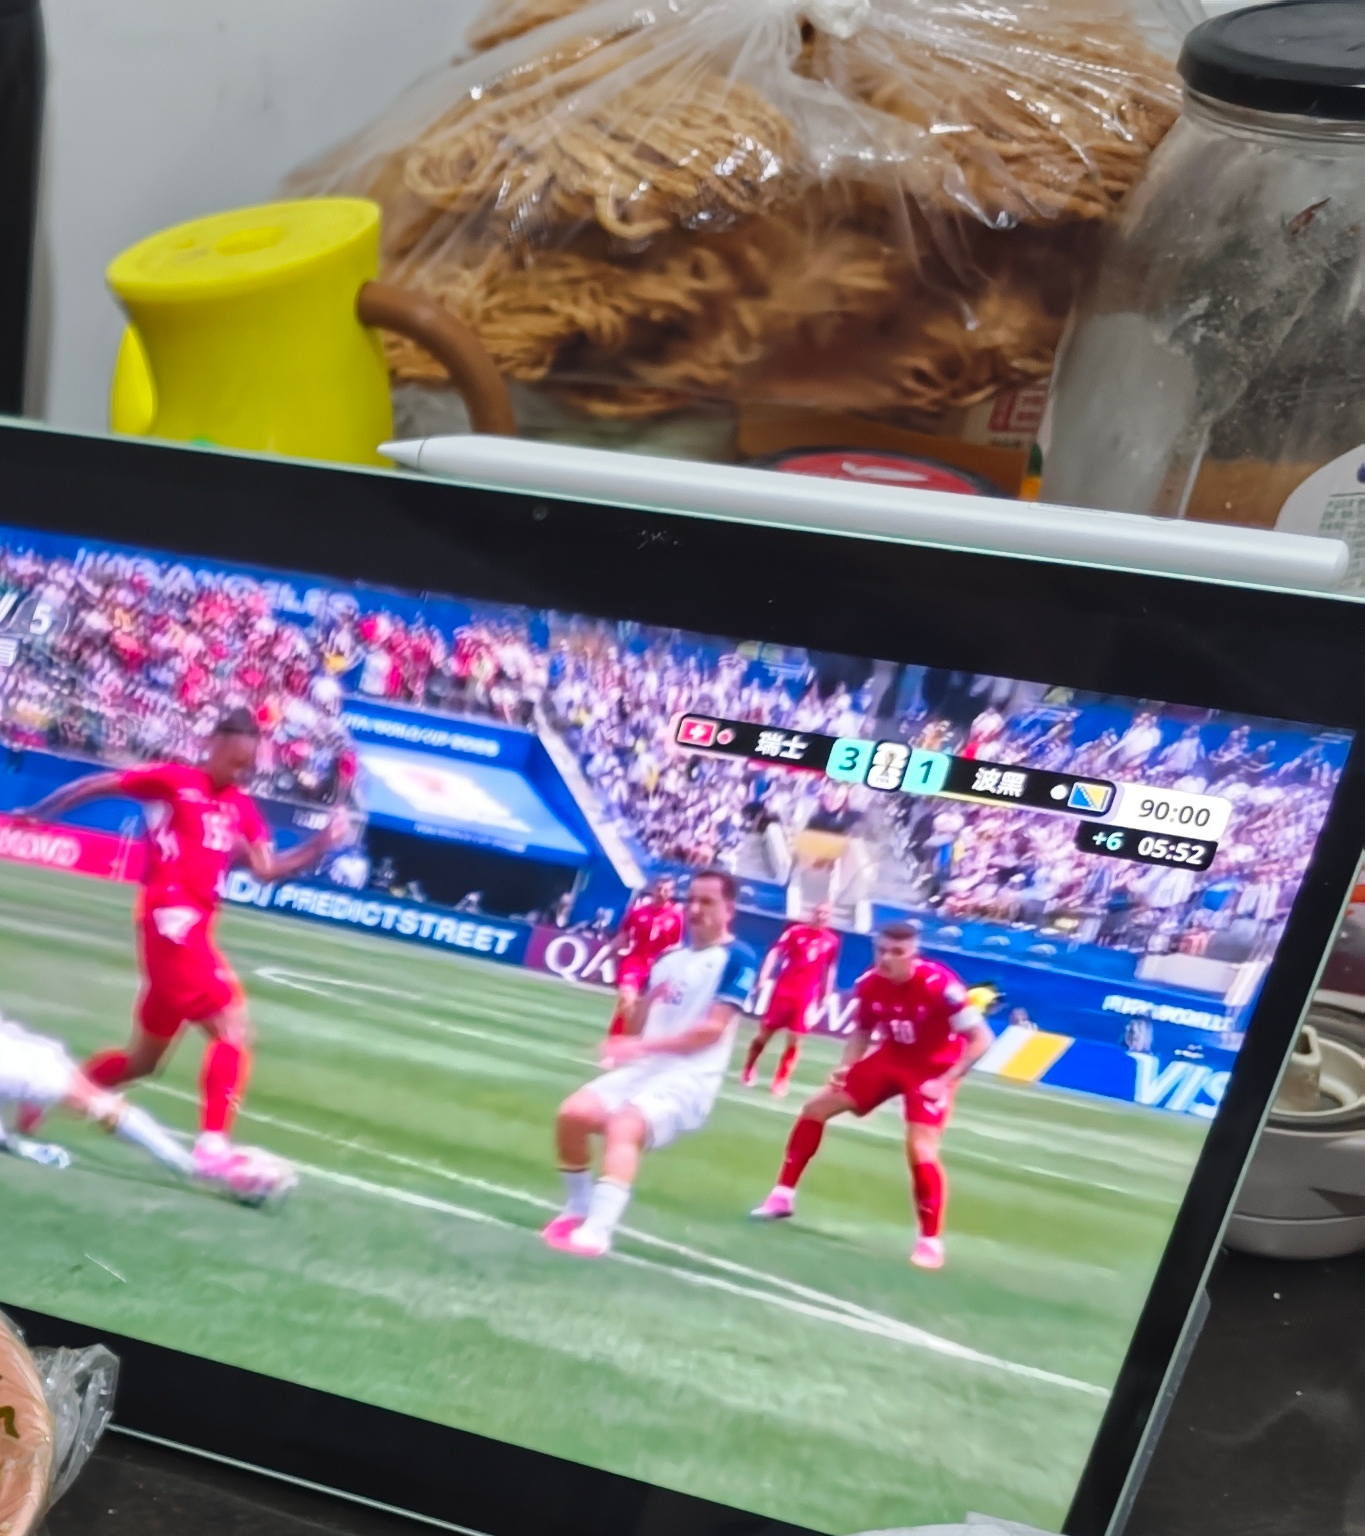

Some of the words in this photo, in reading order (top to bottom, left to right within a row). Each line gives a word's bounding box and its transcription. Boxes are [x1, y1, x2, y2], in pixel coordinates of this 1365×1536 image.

[29, 603, 54, 635] 5
[754, 730, 809, 761] 瑞士
[837, 746, 860, 772] 3
[920, 759, 936, 785] 1
[971, 766, 1028, 798] 波黑
[1138, 798, 1212, 828] 90:00
[1092, 831, 1125, 851] +6
[1137, 836, 1206, 866] 05:52
[273, 882, 517, 955] PREDICTSTREET
